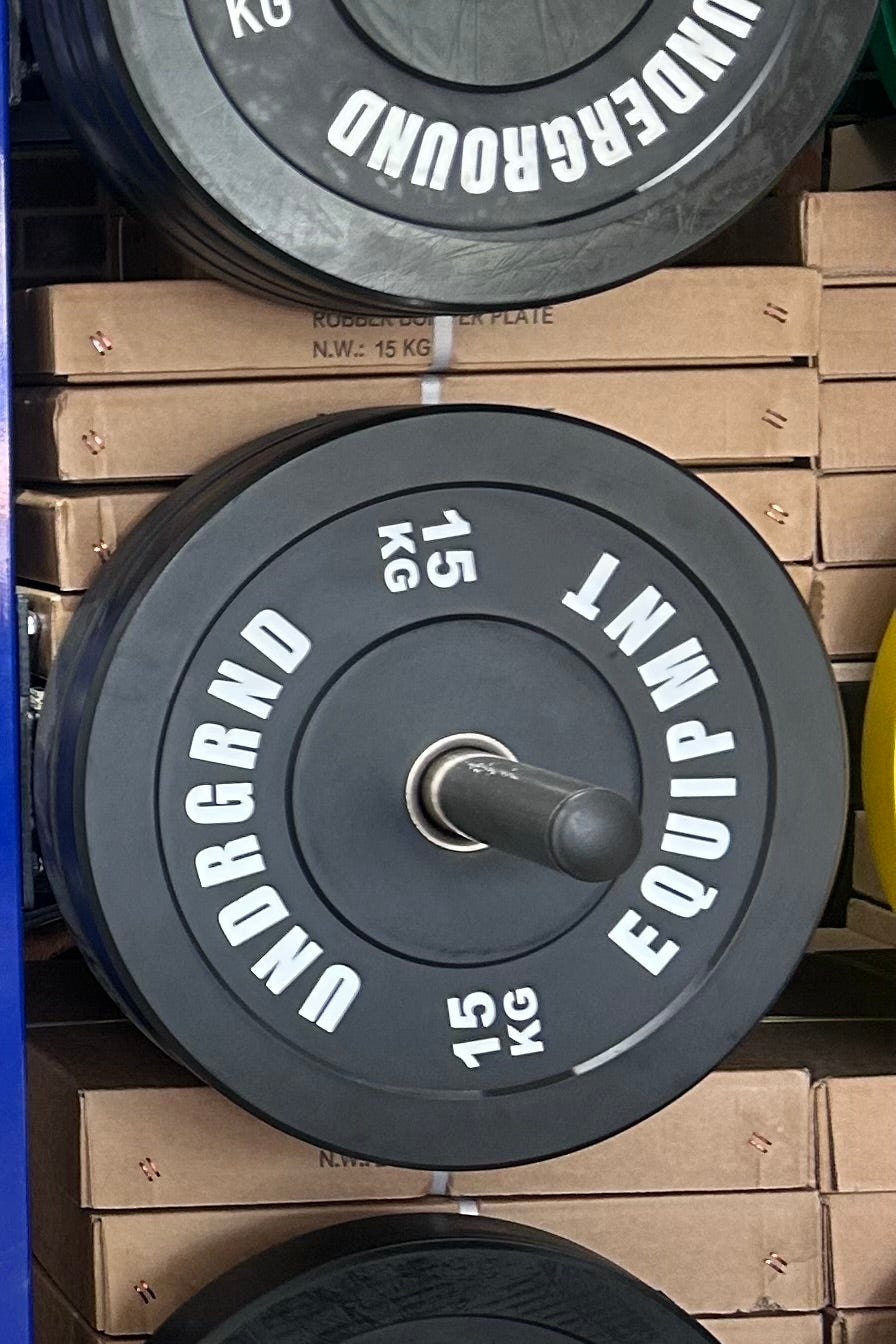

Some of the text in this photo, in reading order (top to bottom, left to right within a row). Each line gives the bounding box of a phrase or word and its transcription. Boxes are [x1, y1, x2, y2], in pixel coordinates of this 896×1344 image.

[375, 340, 398, 358] 15
[403, 338, 431, 357] KG
[377, 521, 421, 593] KG
[419, 509, 478, 589] 15
[561, 552, 737, 976] EQUIPMNT
[185, 609, 362, 1033] UNDRGRND
[446, 991, 499, 1069] 15
[502, 986, 545, 1057] KG
